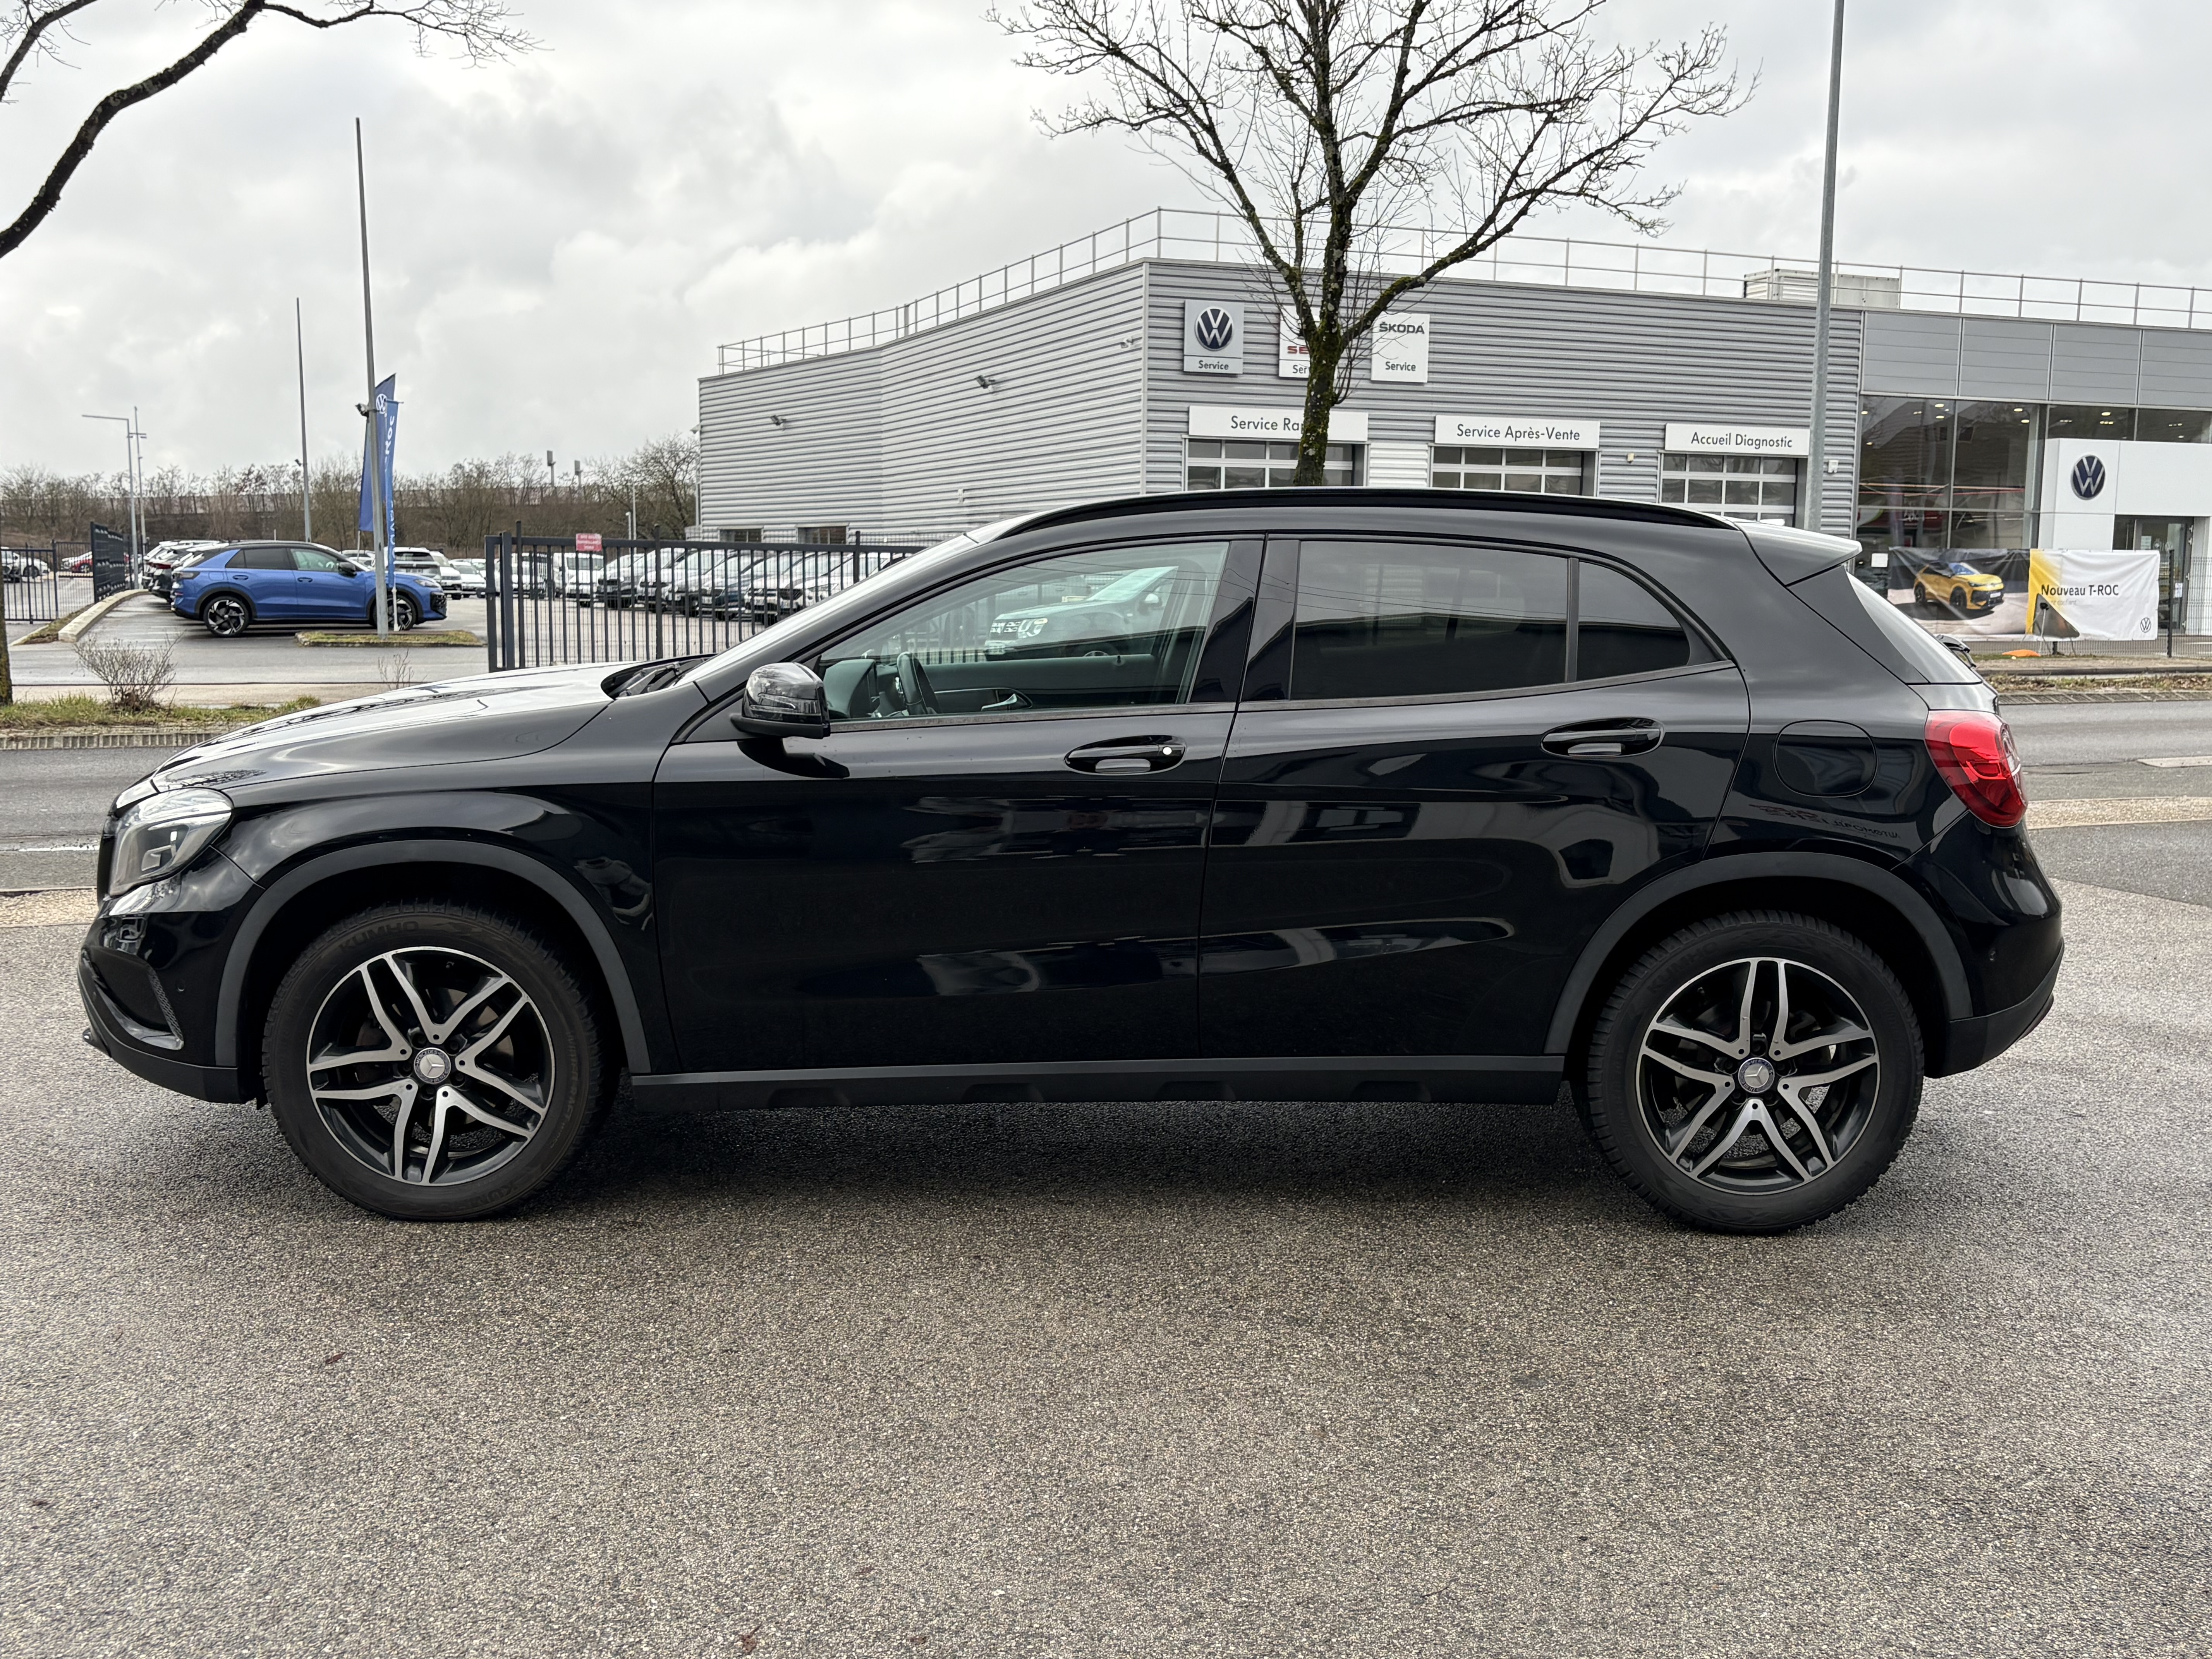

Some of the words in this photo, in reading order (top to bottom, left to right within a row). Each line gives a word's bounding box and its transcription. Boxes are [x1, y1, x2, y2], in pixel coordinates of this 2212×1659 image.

[1379, 321, 1425, 334] ŠKODA
[1287, 346, 1309, 354] SE
[1198, 360, 1229, 370] Service
[1385, 361, 1416, 371] Service
[1231, 416, 1278, 430] Service
[1457, 424, 1501, 438] Service
[1504, 425, 1580, 441] Après-Vente
[1691, 432, 1731, 445] Accueil
[1735, 434, 1792, 449] Diagnostic
[2041, 584, 2085, 596] Nouveau
[2088, 585, 2119, 596] T-ROC
